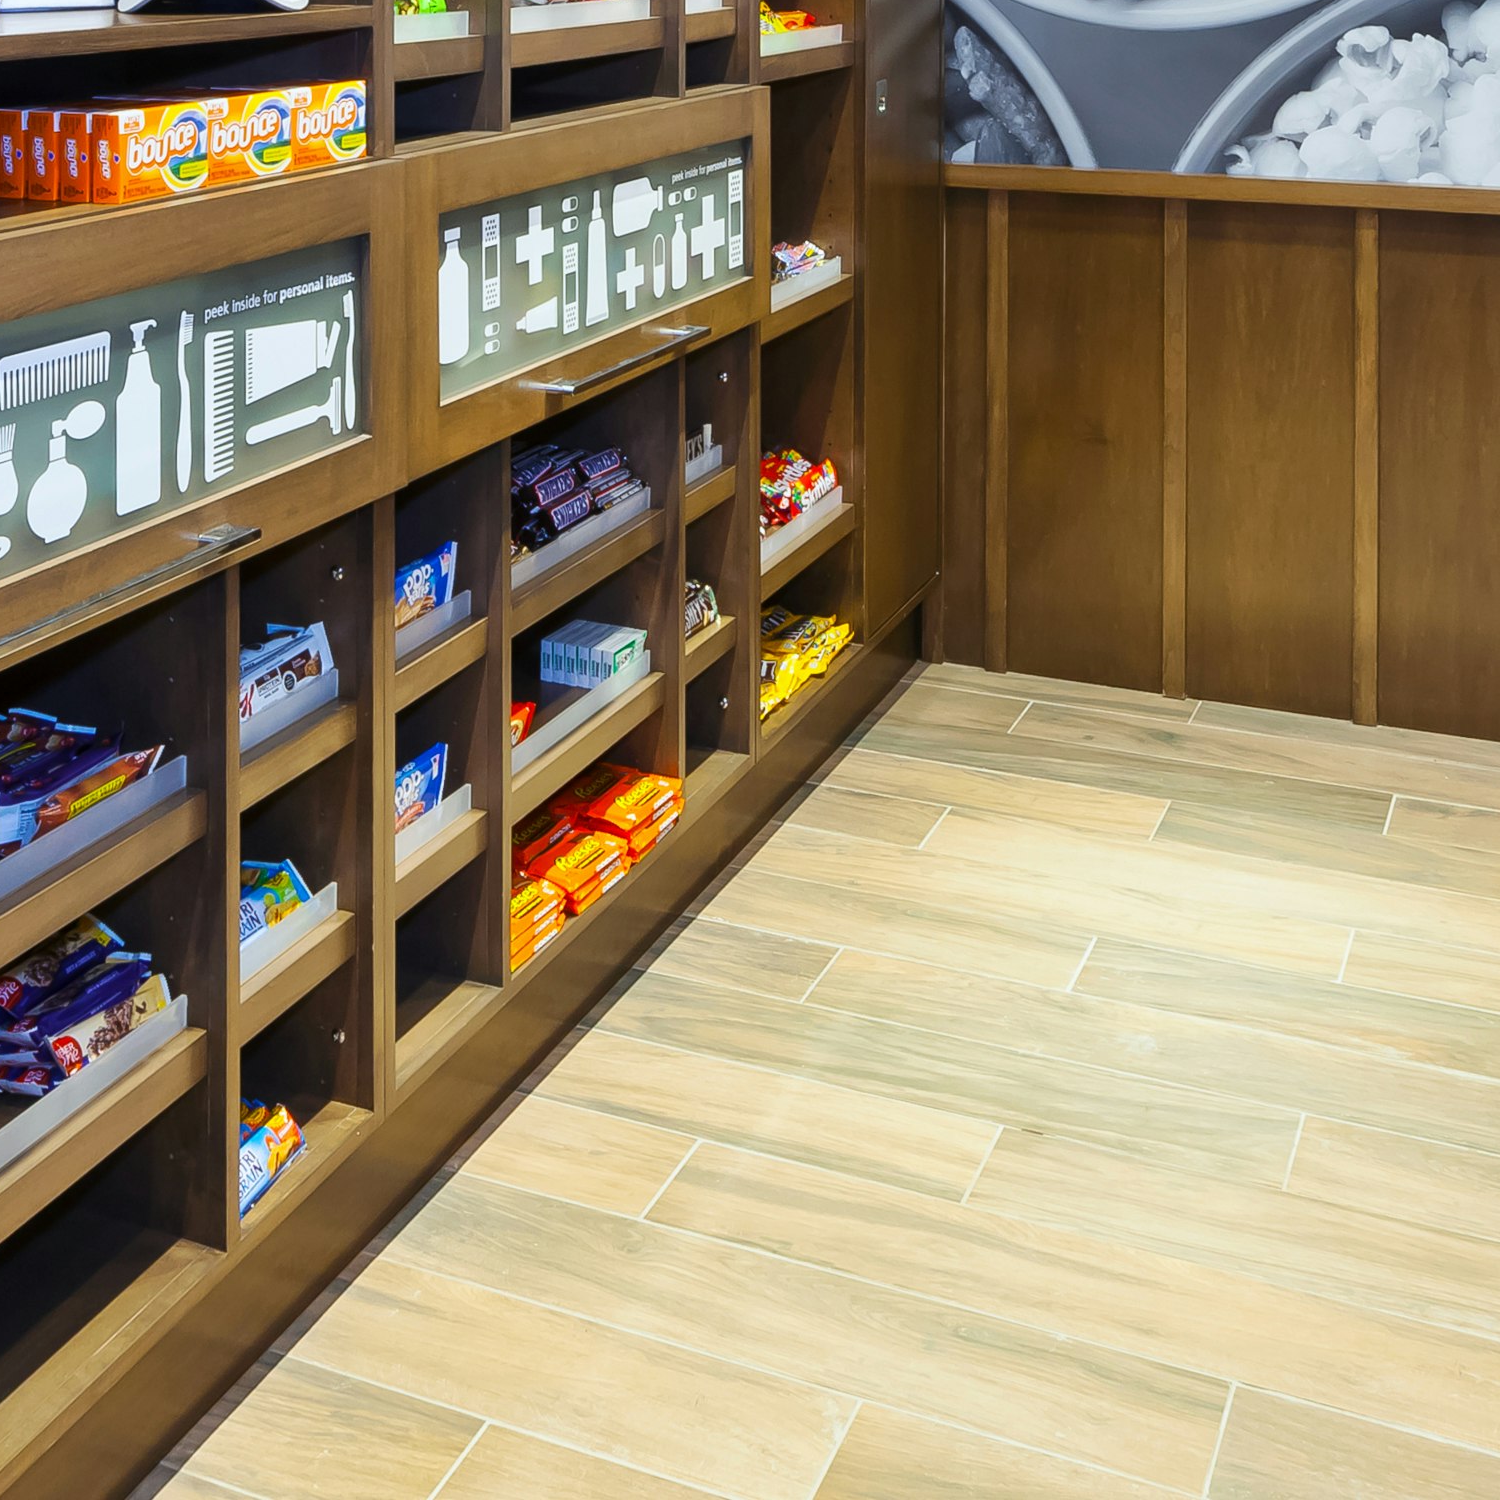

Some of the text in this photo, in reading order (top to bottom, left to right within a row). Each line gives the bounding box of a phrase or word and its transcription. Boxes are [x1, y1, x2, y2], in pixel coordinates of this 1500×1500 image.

[210, 108, 281, 157] bounce
[297, 98, 357, 144] bounce
[127, 121, 199, 175] bounce
[204, 270, 356, 324] peek inside for personal items.
[581, 451, 619, 476] SNICKERS
[538, 472, 573, 503] SNICKERS
[801, 474, 836, 512] Skittles
[553, 494, 588, 529] SNICKERS
